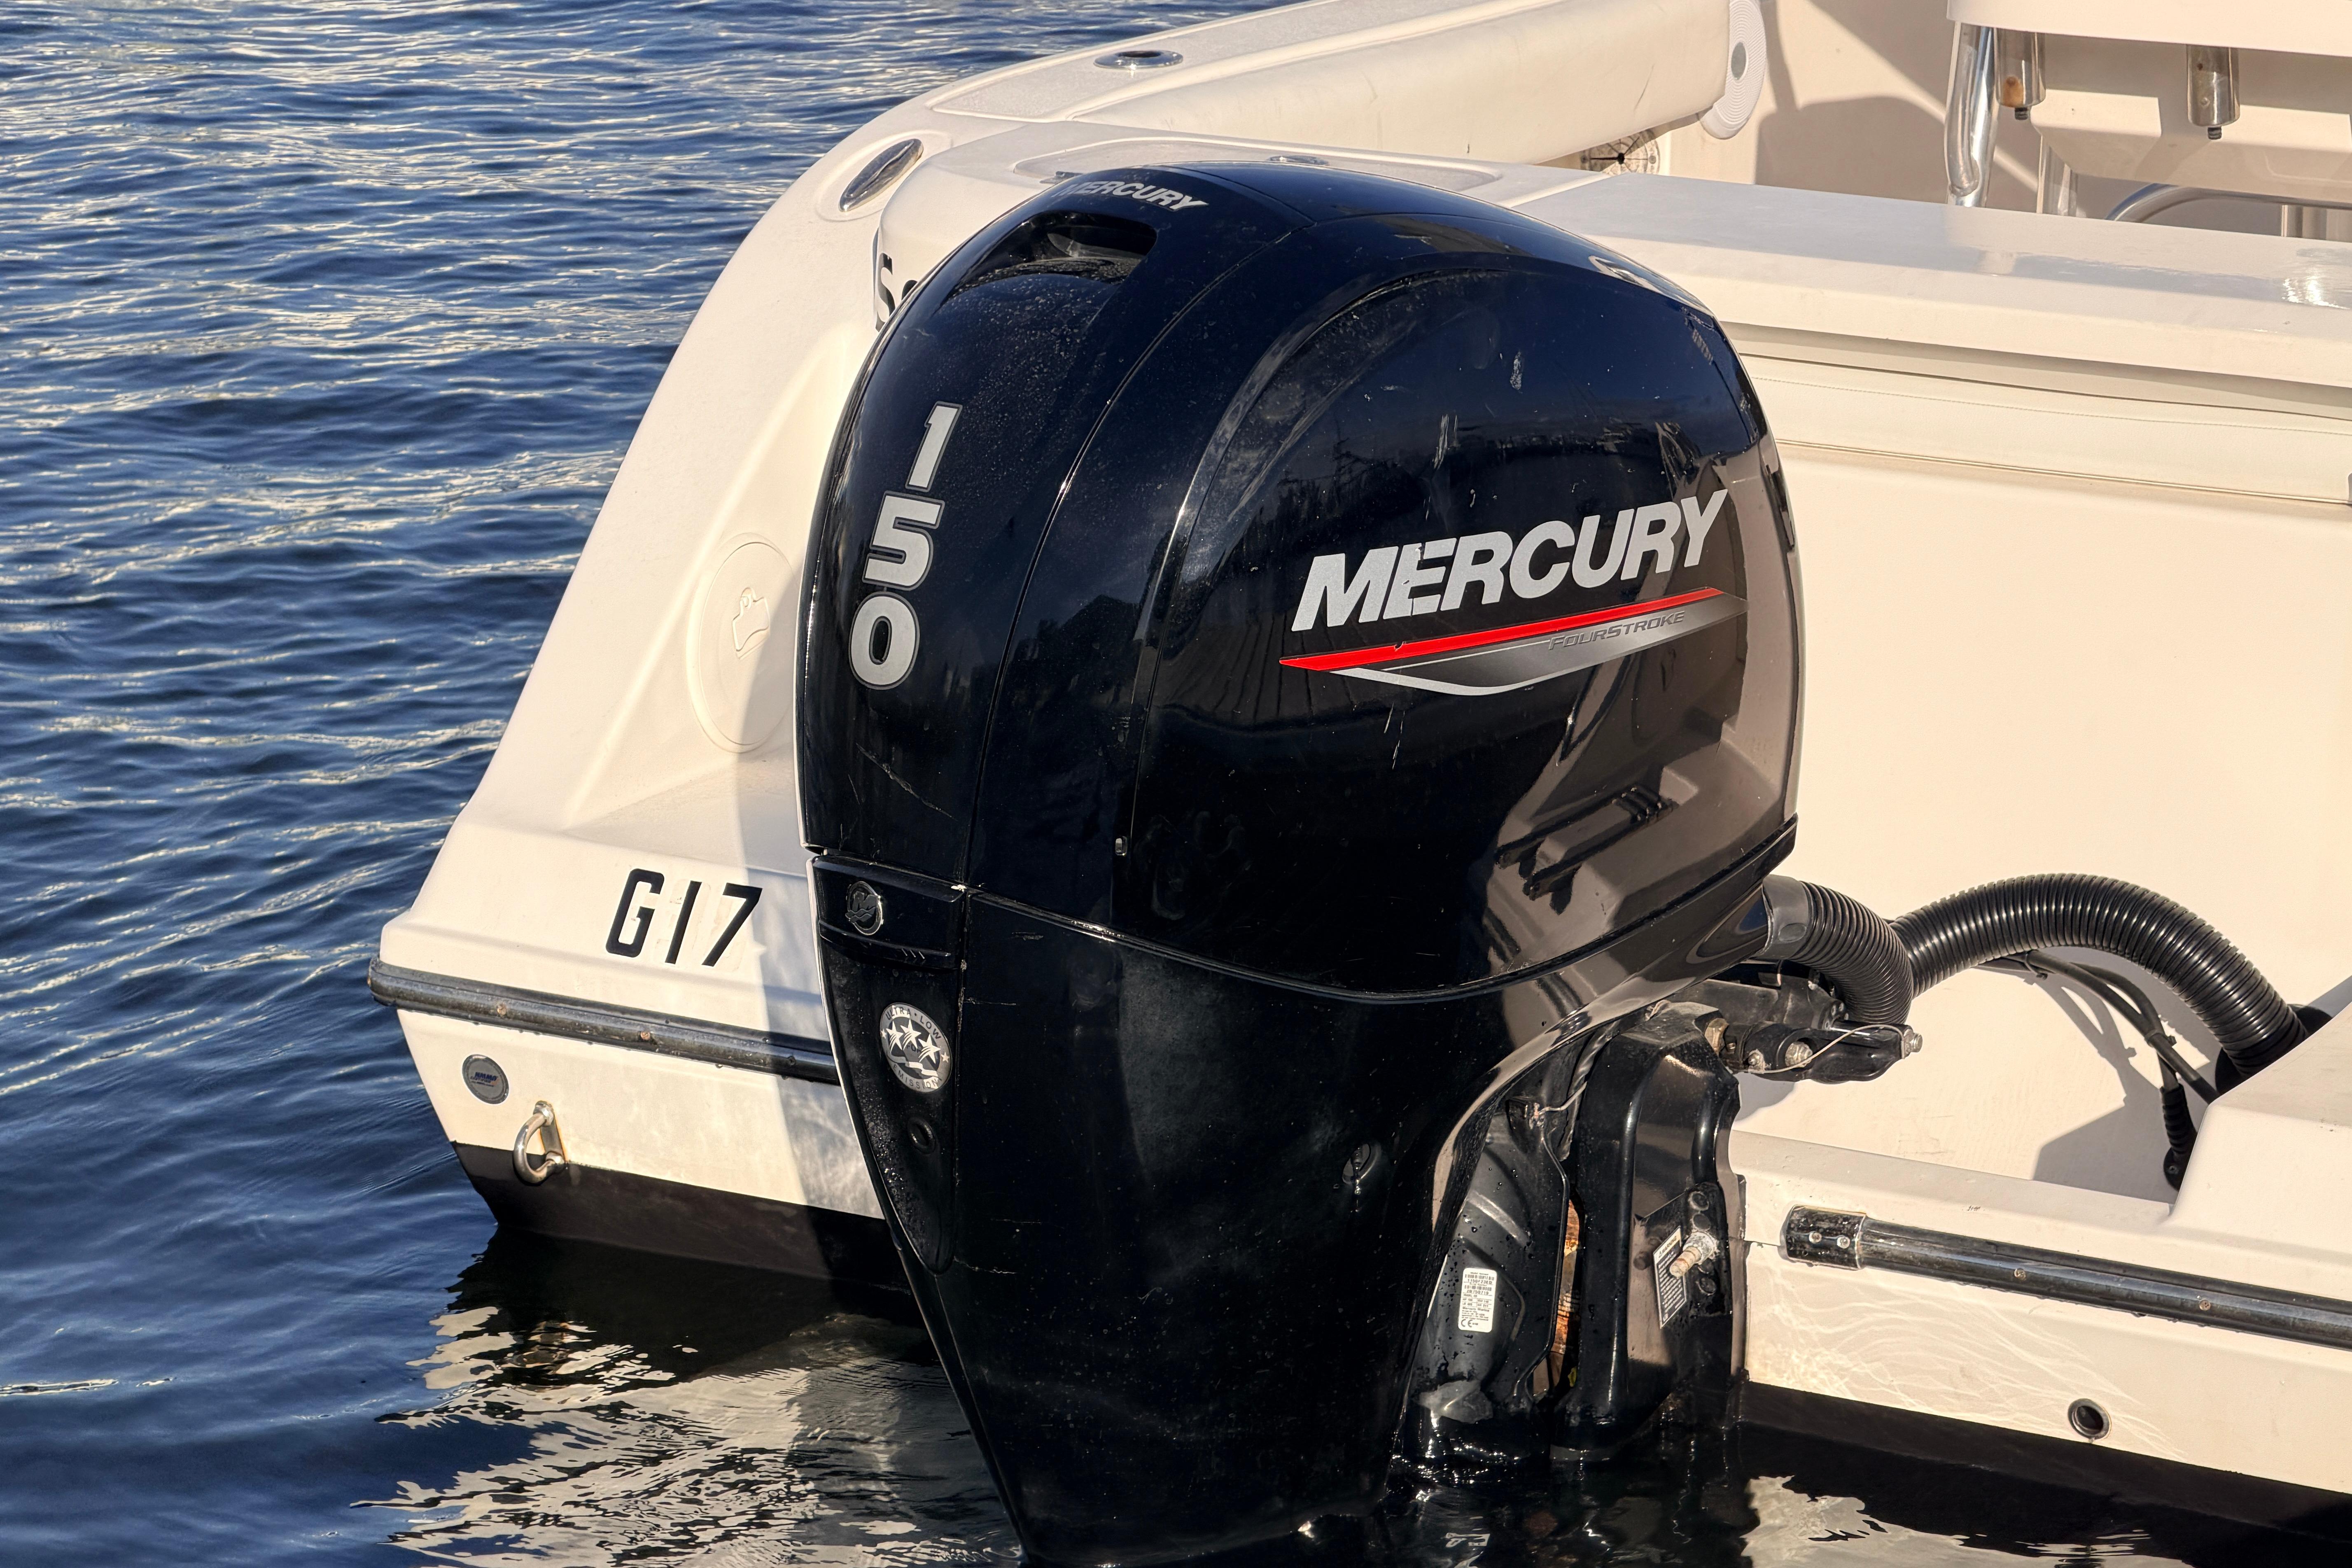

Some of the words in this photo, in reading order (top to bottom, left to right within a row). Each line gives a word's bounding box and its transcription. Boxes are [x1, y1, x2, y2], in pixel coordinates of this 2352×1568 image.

[1050, 181, 1209, 210] MERCURY
[849, 401, 963, 690] 150
[1291, 489, 1728, 632] MERCURY
[886, 1006, 911, 1020] ULTRA
[919, 1015, 942, 1039] LOW
[893, 1064, 939, 1089] EMISSION
